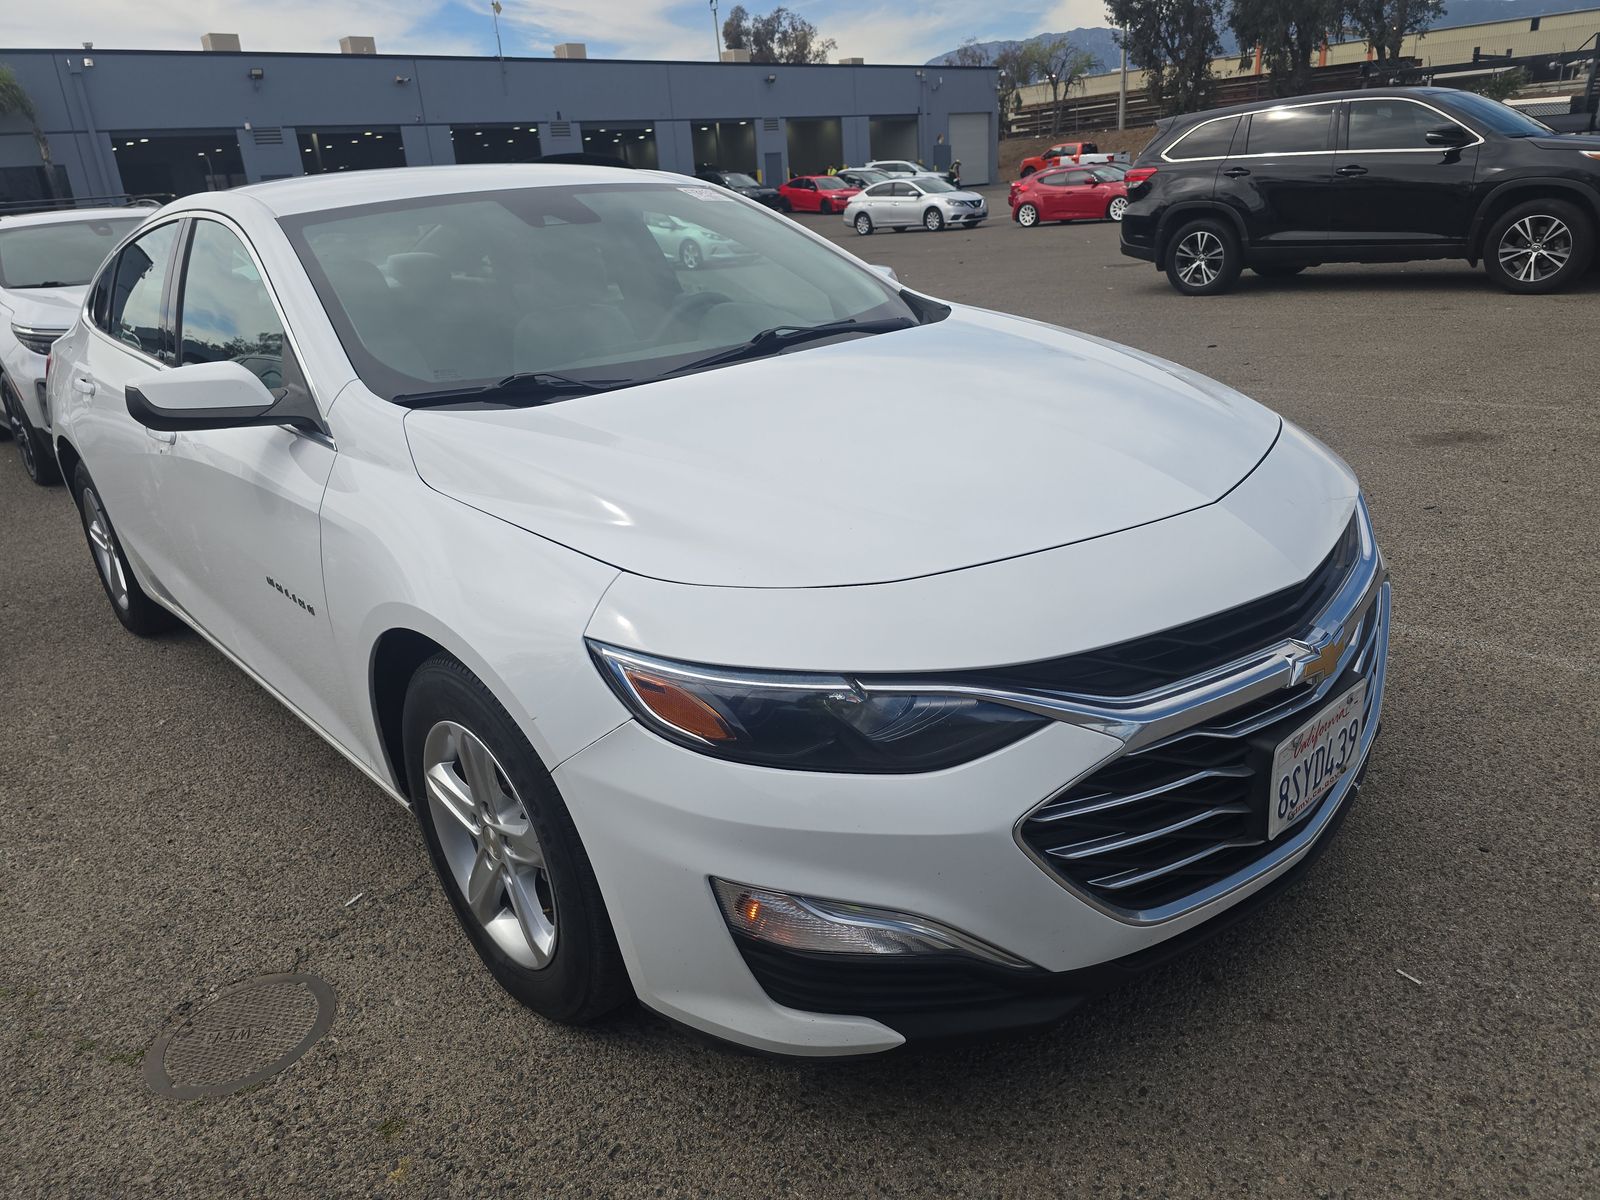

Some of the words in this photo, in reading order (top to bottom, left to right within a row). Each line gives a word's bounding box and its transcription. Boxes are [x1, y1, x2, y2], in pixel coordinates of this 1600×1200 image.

[265, 575, 316, 617] MALIBU
[1293, 705, 1349, 758] California
[1278, 718, 1358, 819] 8SYD439
